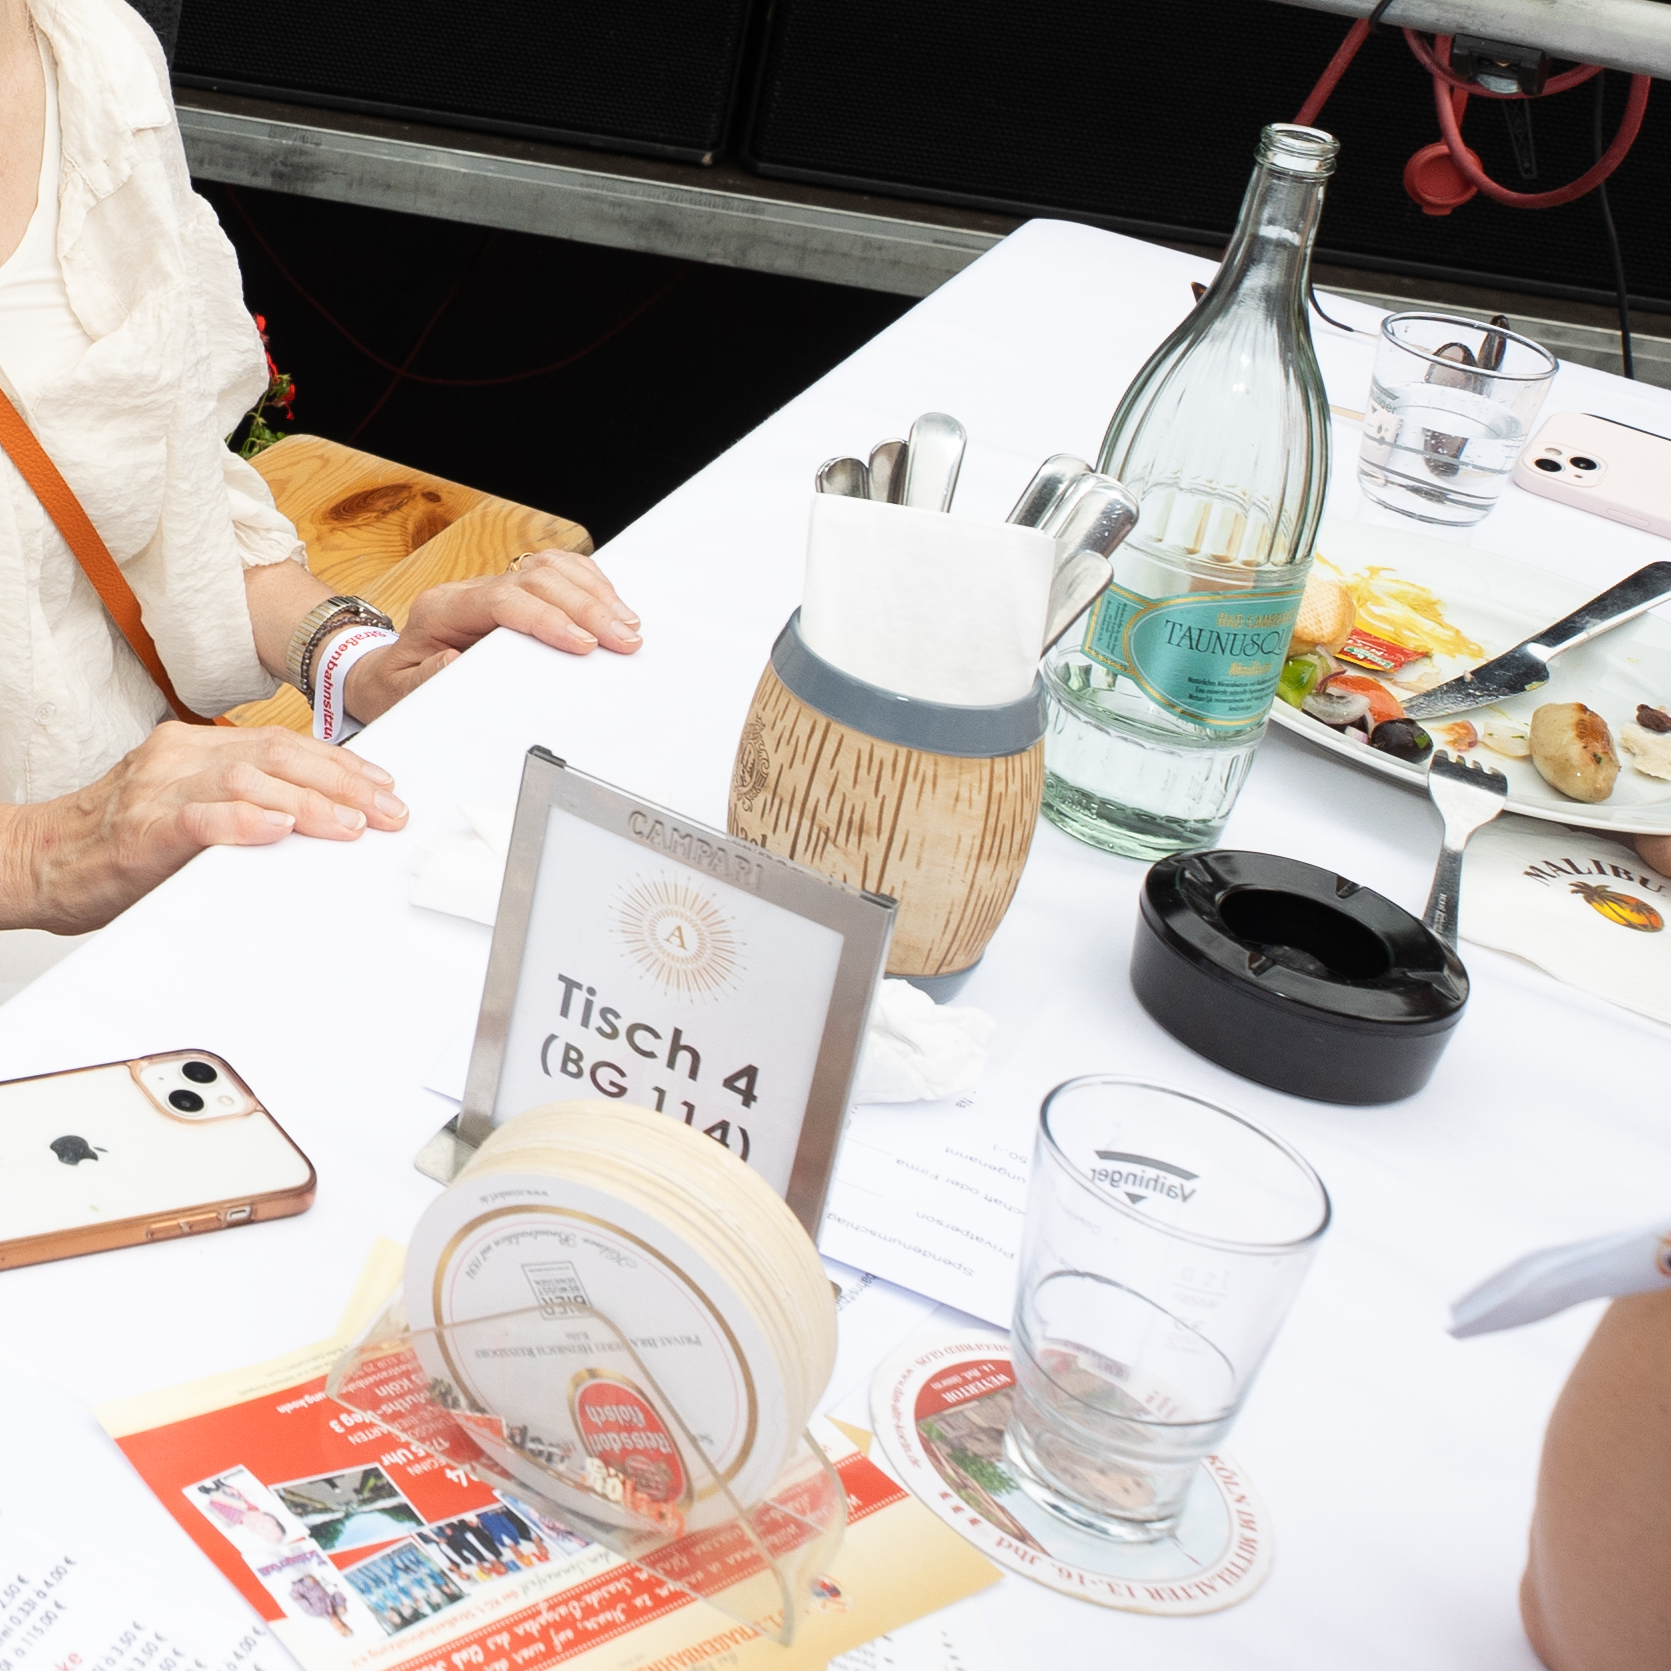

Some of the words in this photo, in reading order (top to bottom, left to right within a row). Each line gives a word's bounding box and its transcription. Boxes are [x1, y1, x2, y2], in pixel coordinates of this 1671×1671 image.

[627, 808, 765, 888] CAMPARI
[1523, 857, 1666, 893] MALIBU
[662, 921, 689, 952] A
[555, 972, 704, 1085] Tisch
[721, 1062, 760, 1111] 4
[539, 1034, 630, 1100] (BG
[895, 1158, 939, 1181] Firma
[944, 1145, 1026, 1184] ungenannt
[944, 1176, 979, 1196] oder
[826, 1213, 974, 1277] Spendenumschlag
[915, 1211, 1015, 1259] Privatperson
[540, 1294, 587, 1316] BIER
[474, 1346, 536, 1360] REISSDORF
[535, 1341, 594, 1358] HEINRICH
[328, 1417, 345, 1435] 3
[585, 1403, 644, 1432] Kölsch
[379, 1444, 414, 1471] Uhr
[16, 1574, 29, 1585] €
[43, 1565, 69, 1590] 4,00
[63, 1556, 76, 1566] €
[53, 1599, 67, 1611] €
[115, 1632, 137, 1658] 3,50
[133, 1621, 147, 1632] €
[134, 1641, 157, 1669] 3,50
[155, 1632, 167, 1643] €
[172, 1647, 185, 1658] €
[234, 1635, 259, 1662] 4,00
[253, 1624, 267, 1636] €
[194, 1659, 205, 1670] €
[448, 1641, 486, 1671] Club
